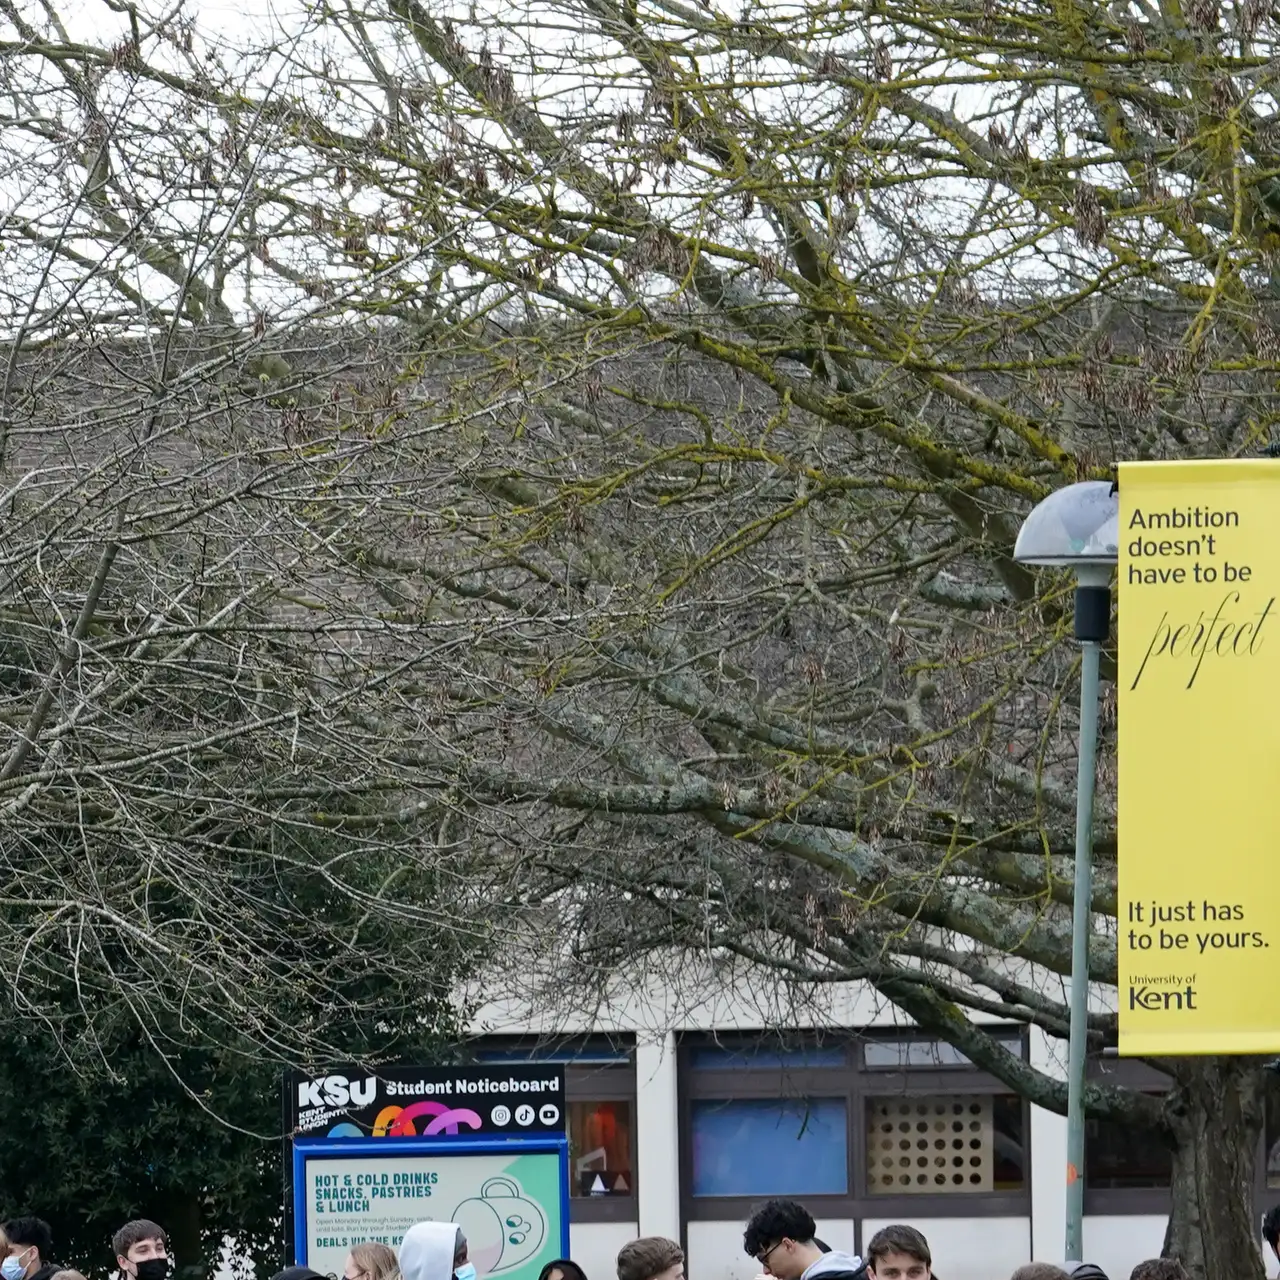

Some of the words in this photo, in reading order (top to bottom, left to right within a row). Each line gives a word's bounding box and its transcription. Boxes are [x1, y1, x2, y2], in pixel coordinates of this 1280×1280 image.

[1128, 506, 1240, 530] Ambition
[1128, 534, 1216, 557] doesn't
[1128, 563, 1186, 585] have
[1193, 562, 1218, 584] to
[1224, 561, 1252, 583] be
[1130, 590, 1278, 691] perfect
[1128, 901, 1144, 922] It
[1149, 900, 1196, 928] just
[1203, 900, 1244, 921] has
[1128, 929, 1153, 950] to
[1160, 928, 1189, 950] be
[1196, 931, 1270, 955] yours.
[1129, 974, 1183, 987] University
[1185, 973, 1197, 985] of
[1129, 986, 1197, 1010] Kent
[298, 1075, 377, 1107] KSU
[386, 1078, 452, 1096] Student
[456, 1077, 559, 1095] Noticeboard
[298, 1106, 326, 1119] KENT
[315, 1175, 339, 1187] HOT
[344, 1175, 352, 1187] &
[357, 1173, 389, 1186] COLD
[393, 1172, 438, 1185] DRINKS
[372, 1185, 432, 1199] PASTRIES
[316, 1201, 325, 1213] &
[329, 1200, 370, 1213] LUNCH
[316, 1218, 334, 1227] Open
[335, 1217, 361, 1226] Monday
[362, 1217, 389, 1226] through
[316, 1237, 348, 1248] DEALS
